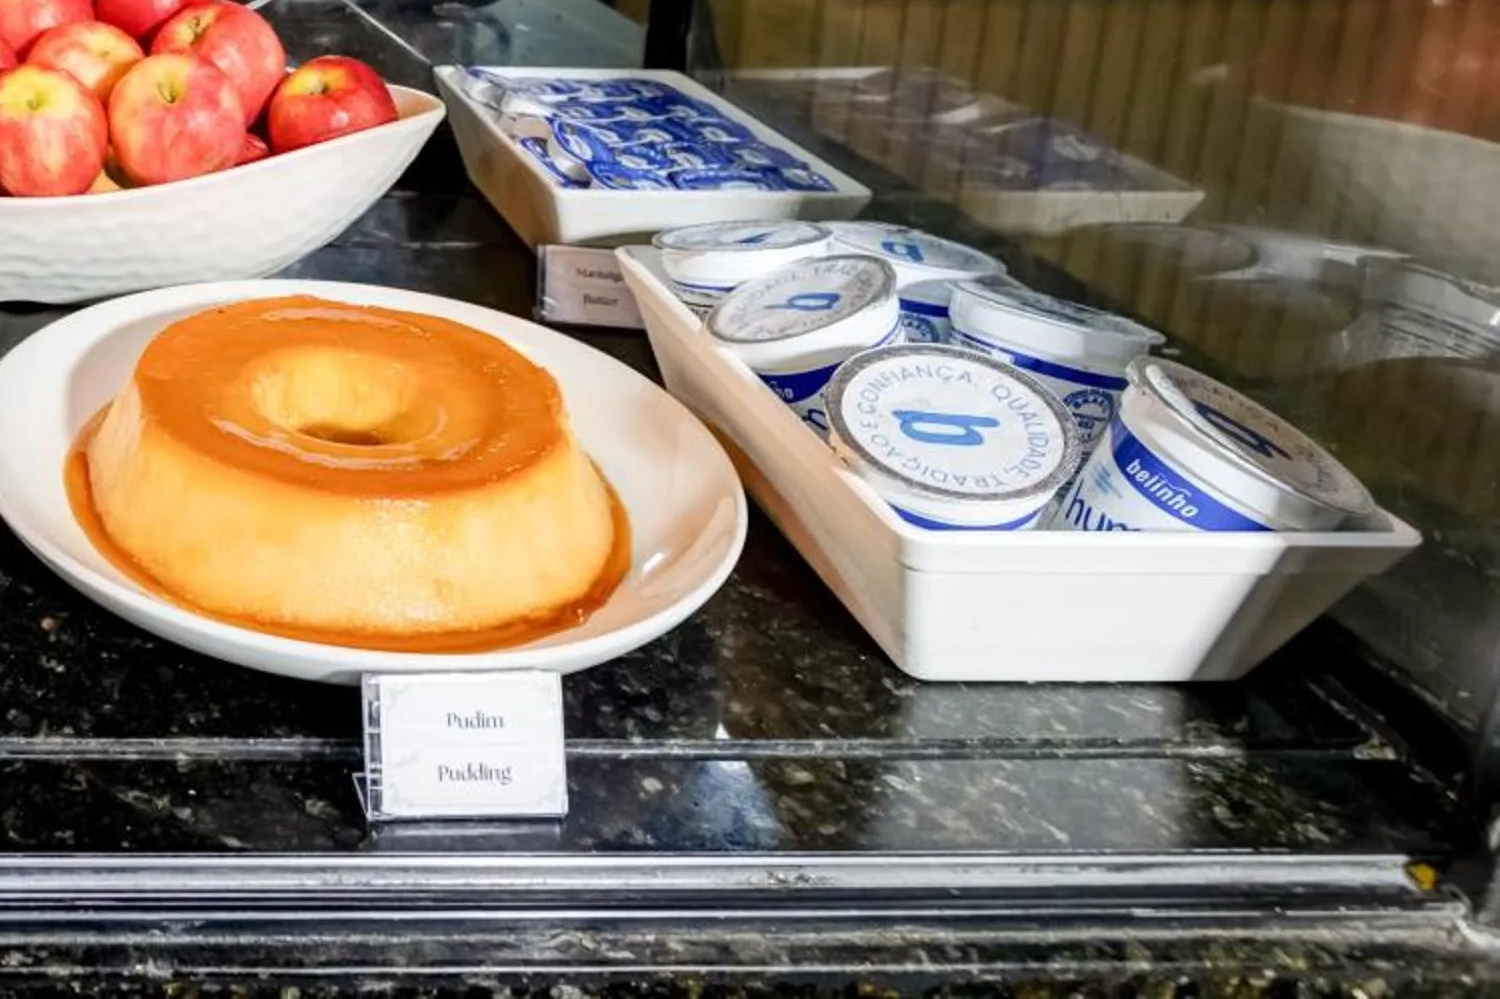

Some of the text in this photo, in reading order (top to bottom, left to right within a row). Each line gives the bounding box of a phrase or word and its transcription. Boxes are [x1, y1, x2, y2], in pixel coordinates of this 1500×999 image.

[991, 385, 1049, 478] QUALIDADE,
[1125, 458, 1199, 518] belinho
[446, 709, 505, 730] Pudim
[437, 762, 514, 786] Pudding
